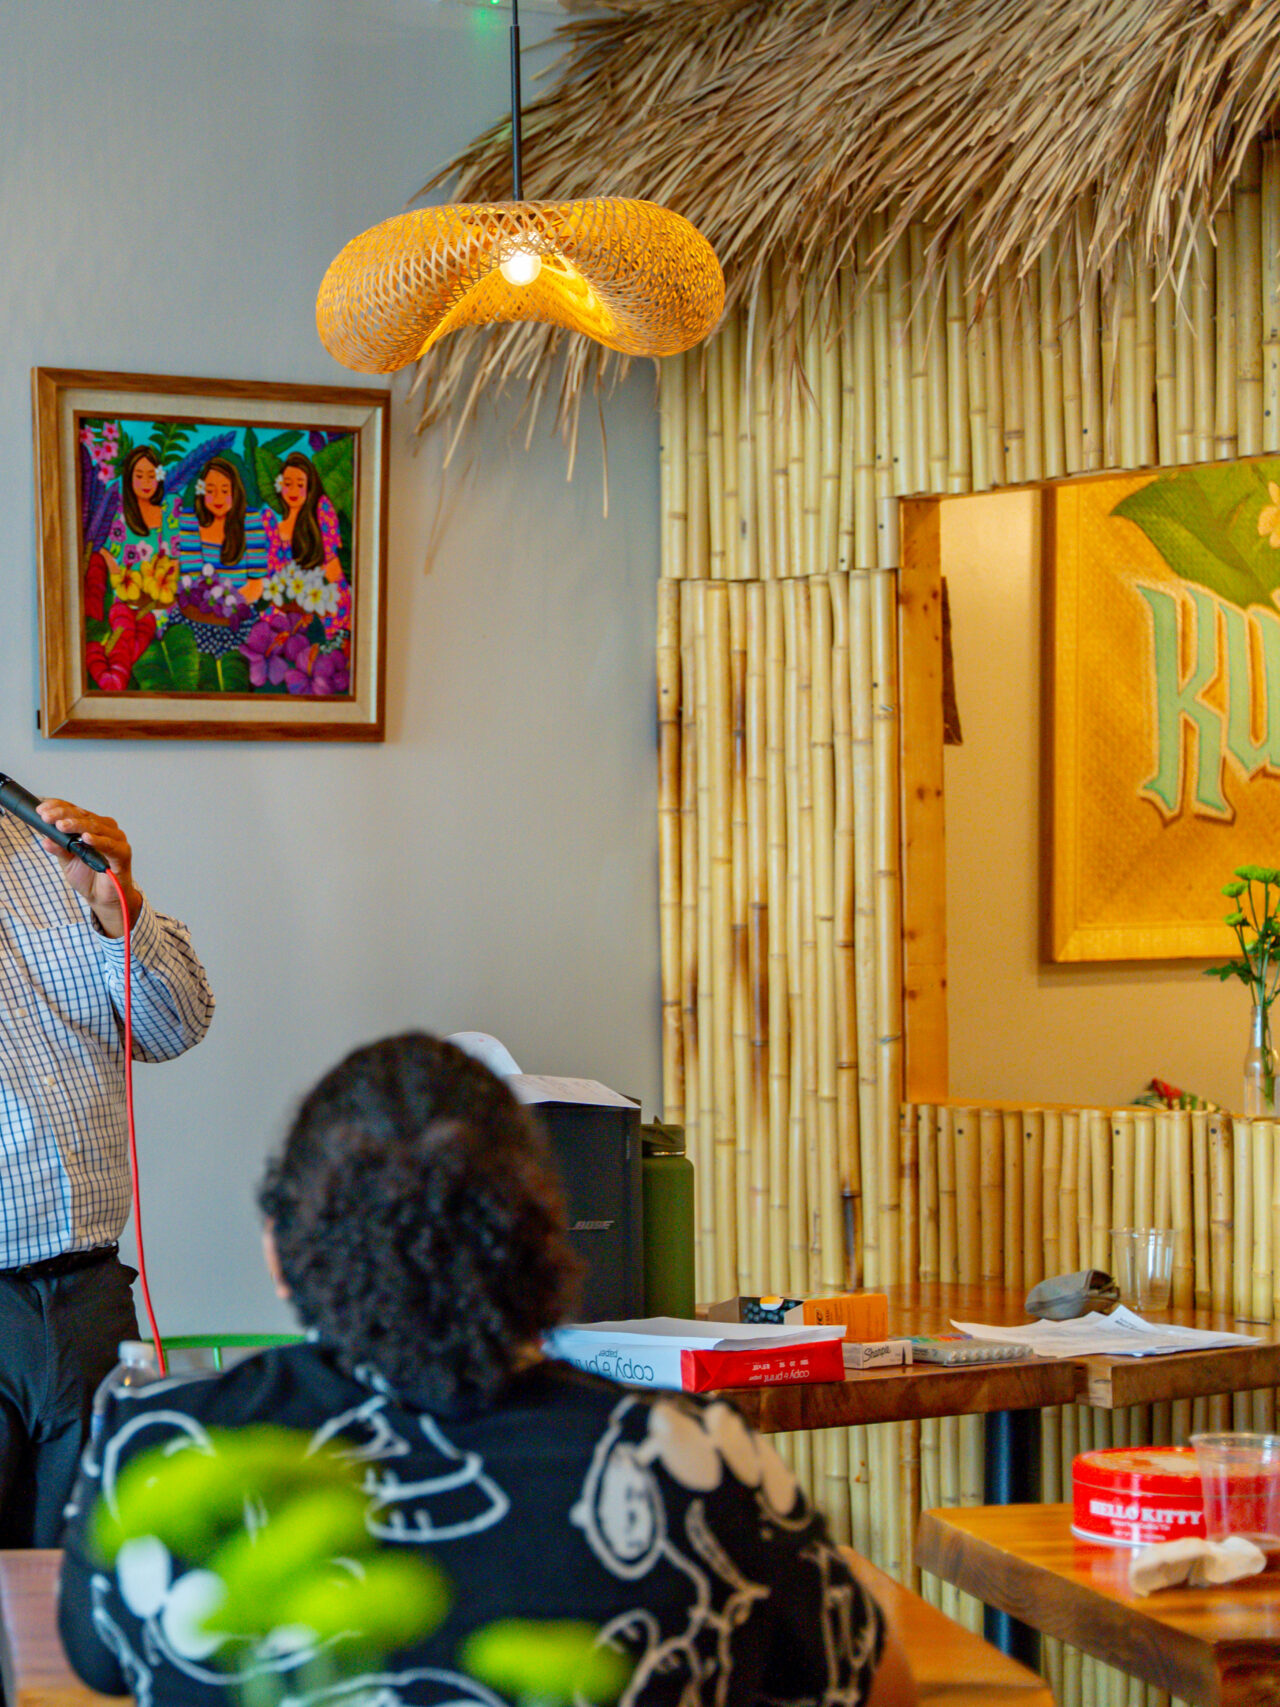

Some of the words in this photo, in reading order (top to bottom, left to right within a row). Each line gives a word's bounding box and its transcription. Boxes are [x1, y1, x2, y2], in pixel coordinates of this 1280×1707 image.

[570, 1220, 615, 1230] BOSE
[598, 1350, 618, 1358] paper
[615, 1357, 655, 1382] copy
[789, 1368, 810, 1380] copy
[1089, 1500, 1140, 1521] HELLO
[1141, 1507, 1203, 1525] KITTY
